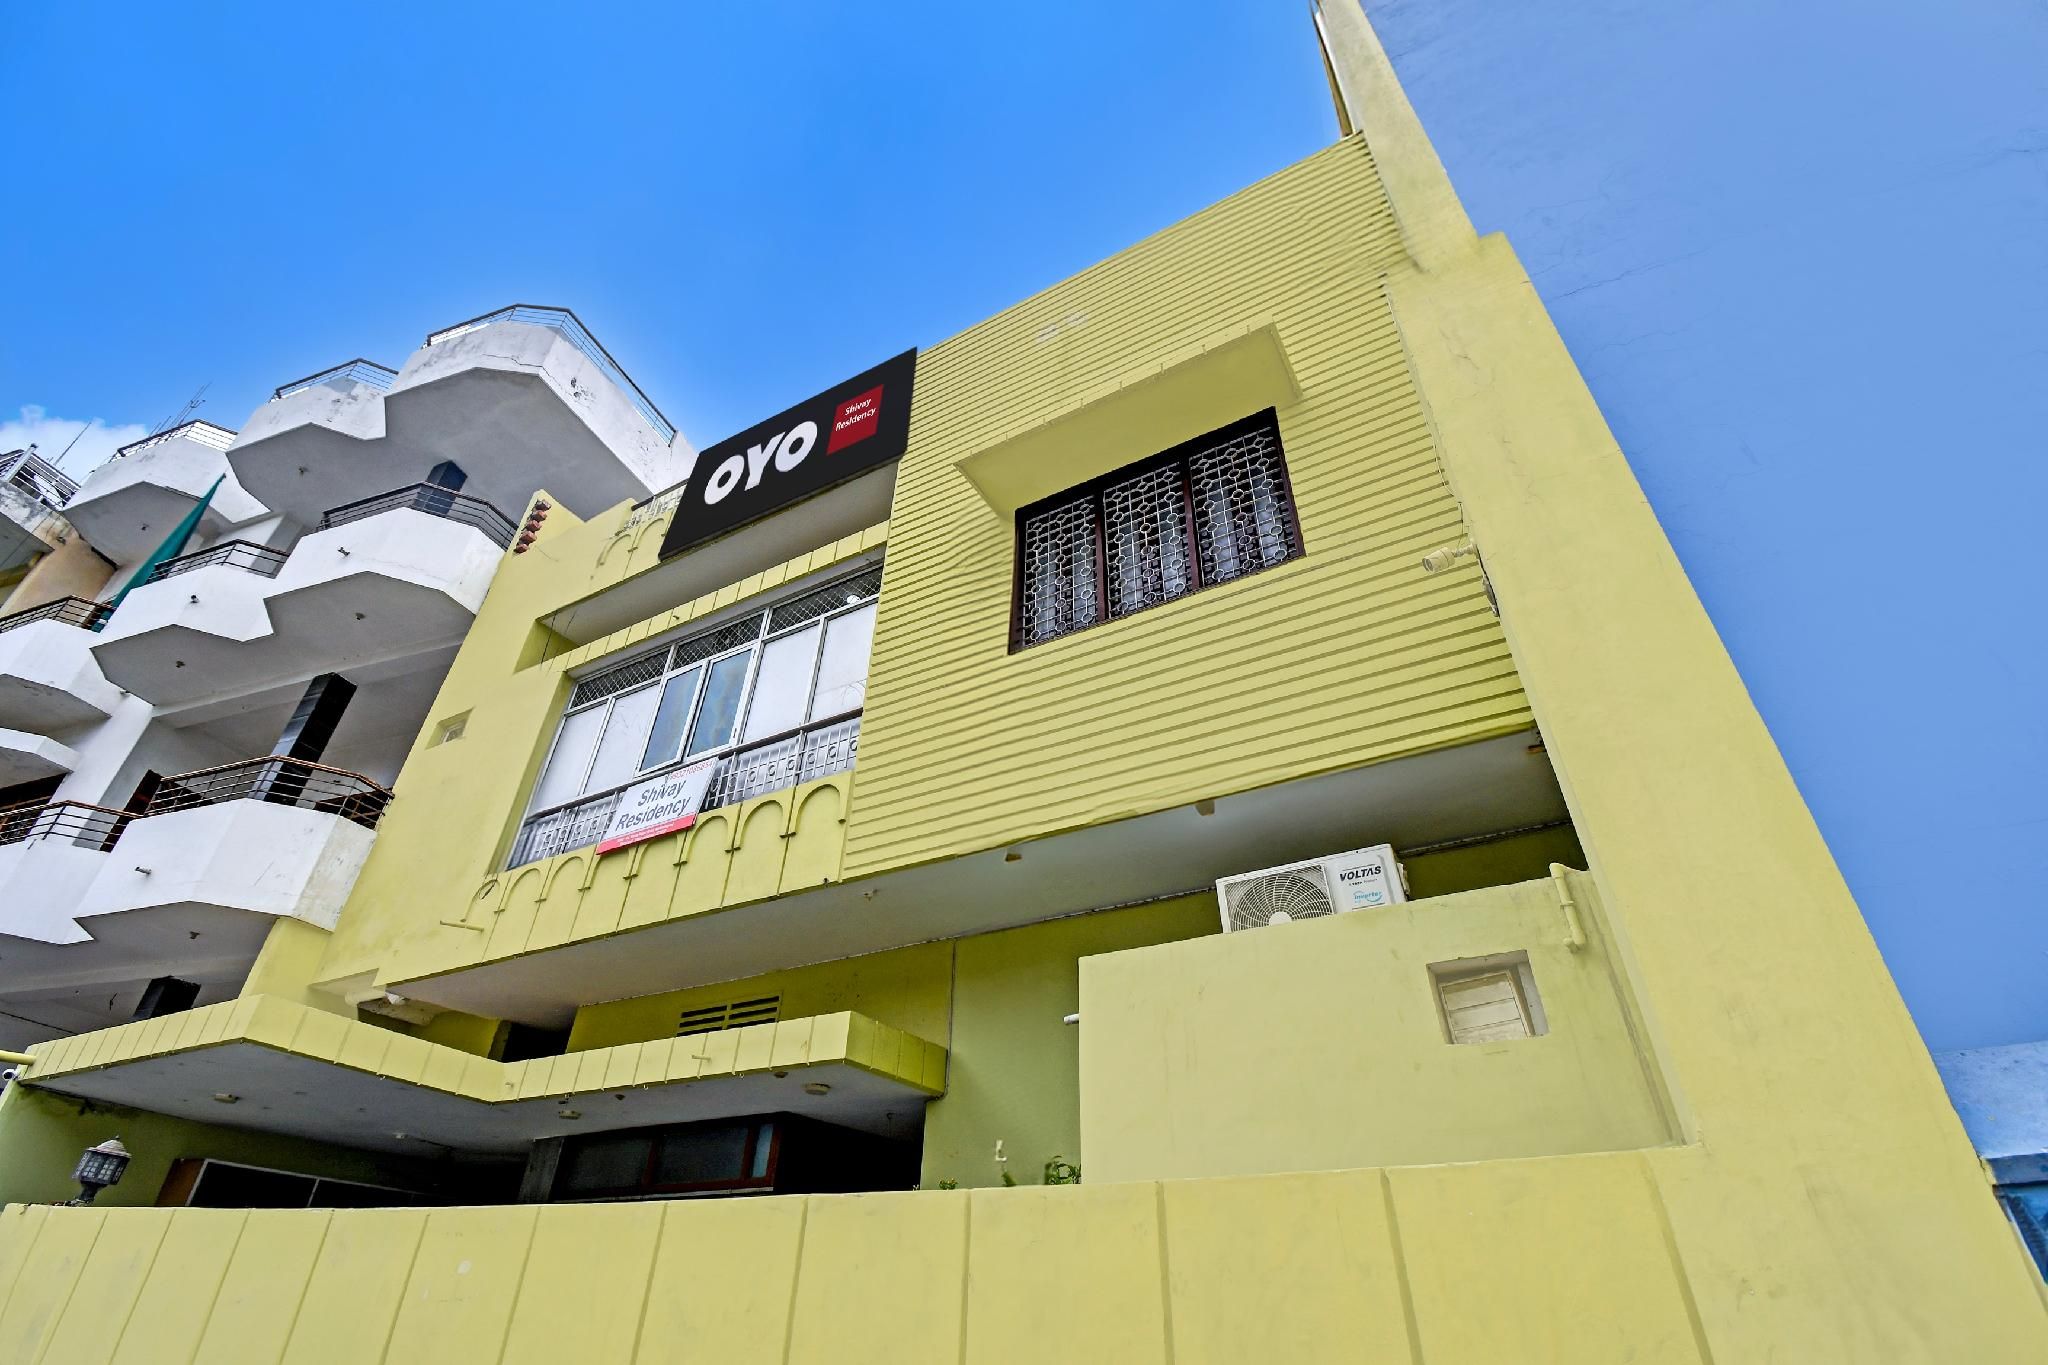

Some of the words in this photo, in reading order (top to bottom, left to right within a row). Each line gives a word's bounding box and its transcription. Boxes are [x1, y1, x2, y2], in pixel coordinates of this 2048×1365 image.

[835, 407, 877, 432] Residency
[845, 398, 872, 416] Shivay
[704, 420, 818, 505] OYO
[637, 780, 687, 807] Shivay
[615, 796, 692, 832] Residency
[1340, 866, 1381, 881] VOLTAS
